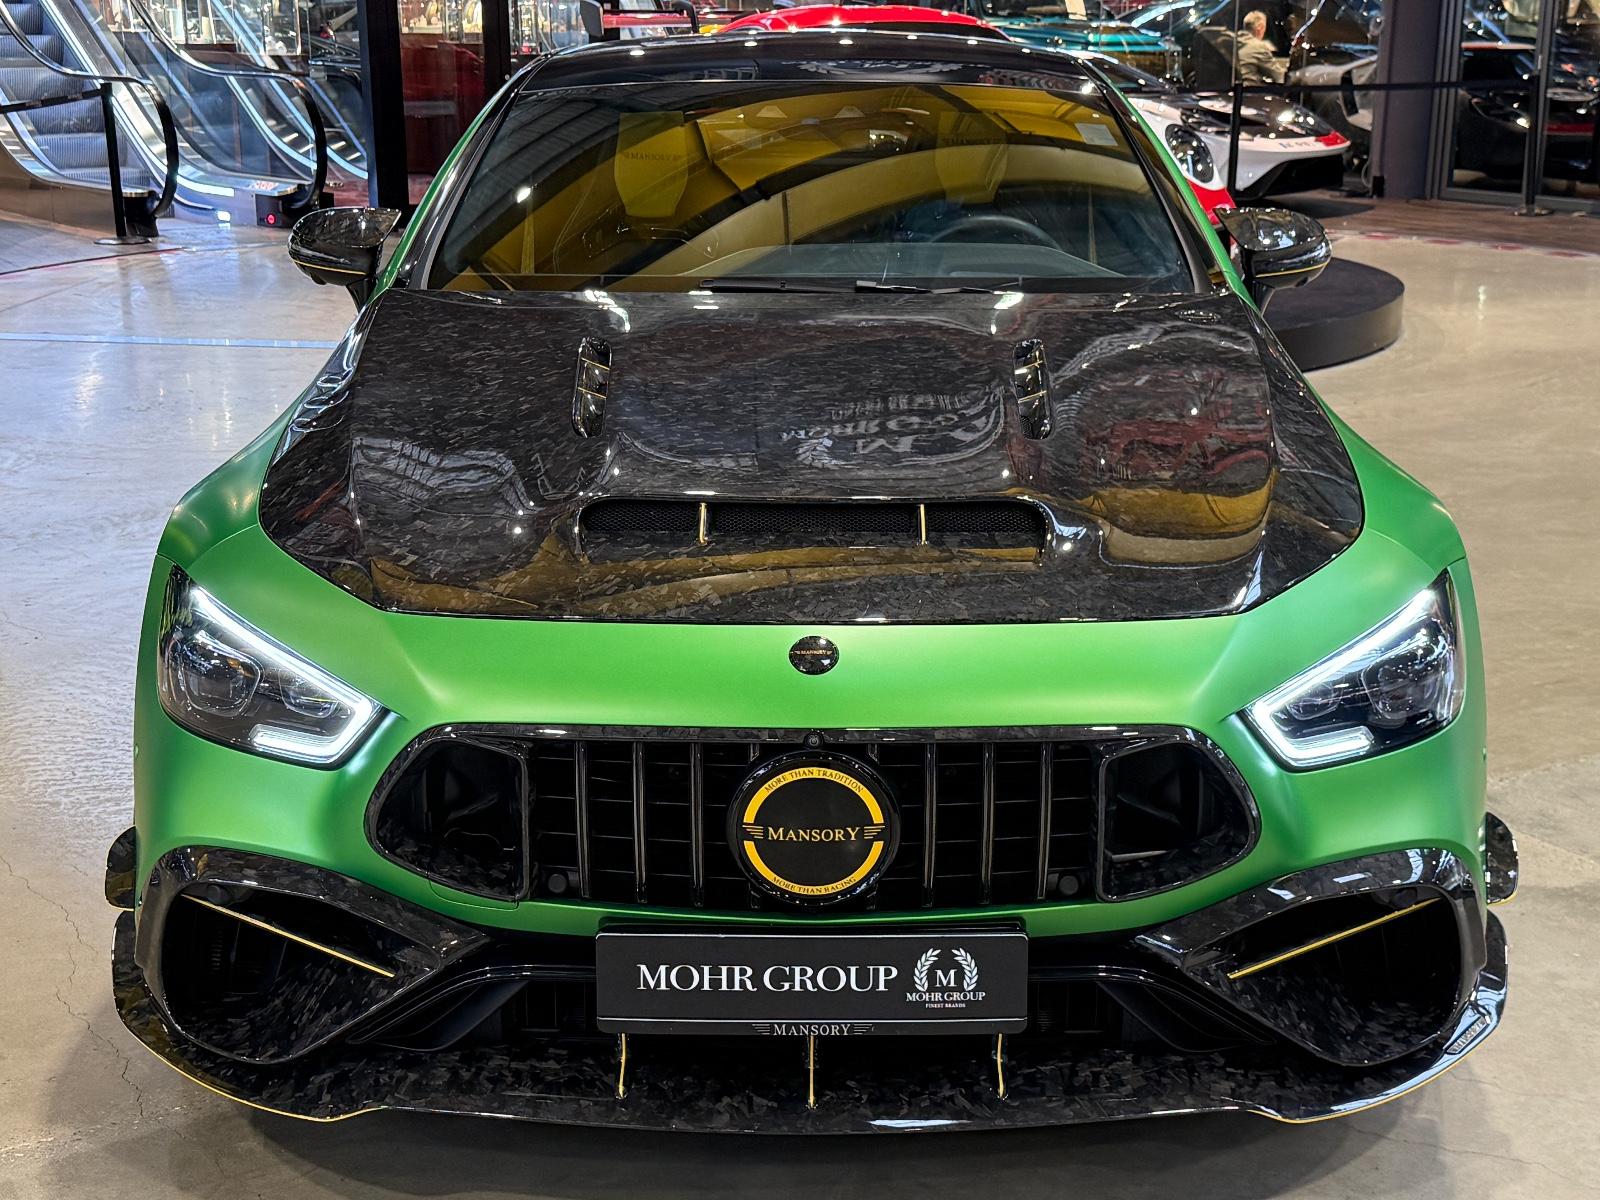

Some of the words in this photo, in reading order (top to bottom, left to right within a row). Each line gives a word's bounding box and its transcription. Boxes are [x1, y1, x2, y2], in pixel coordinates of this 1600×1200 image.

[764, 776, 788, 793] MORE
[789, 769, 814, 780] THAN
[816, 769, 864, 793] TRADITION
[768, 826, 861, 842] MANSORY
[772, 876, 796, 891] MORE
[797, 885, 823, 895] THAN
[823, 876, 858, 893] RACING
[636, 964, 757, 992] MOHR
[763, 964, 898, 992] GROUP
[934, 968, 958, 988] M
[905, 992, 944, 1002] MOHR
[944, 991, 986, 1002] GROUP
[773, 1023, 851, 1036] MANSORY
